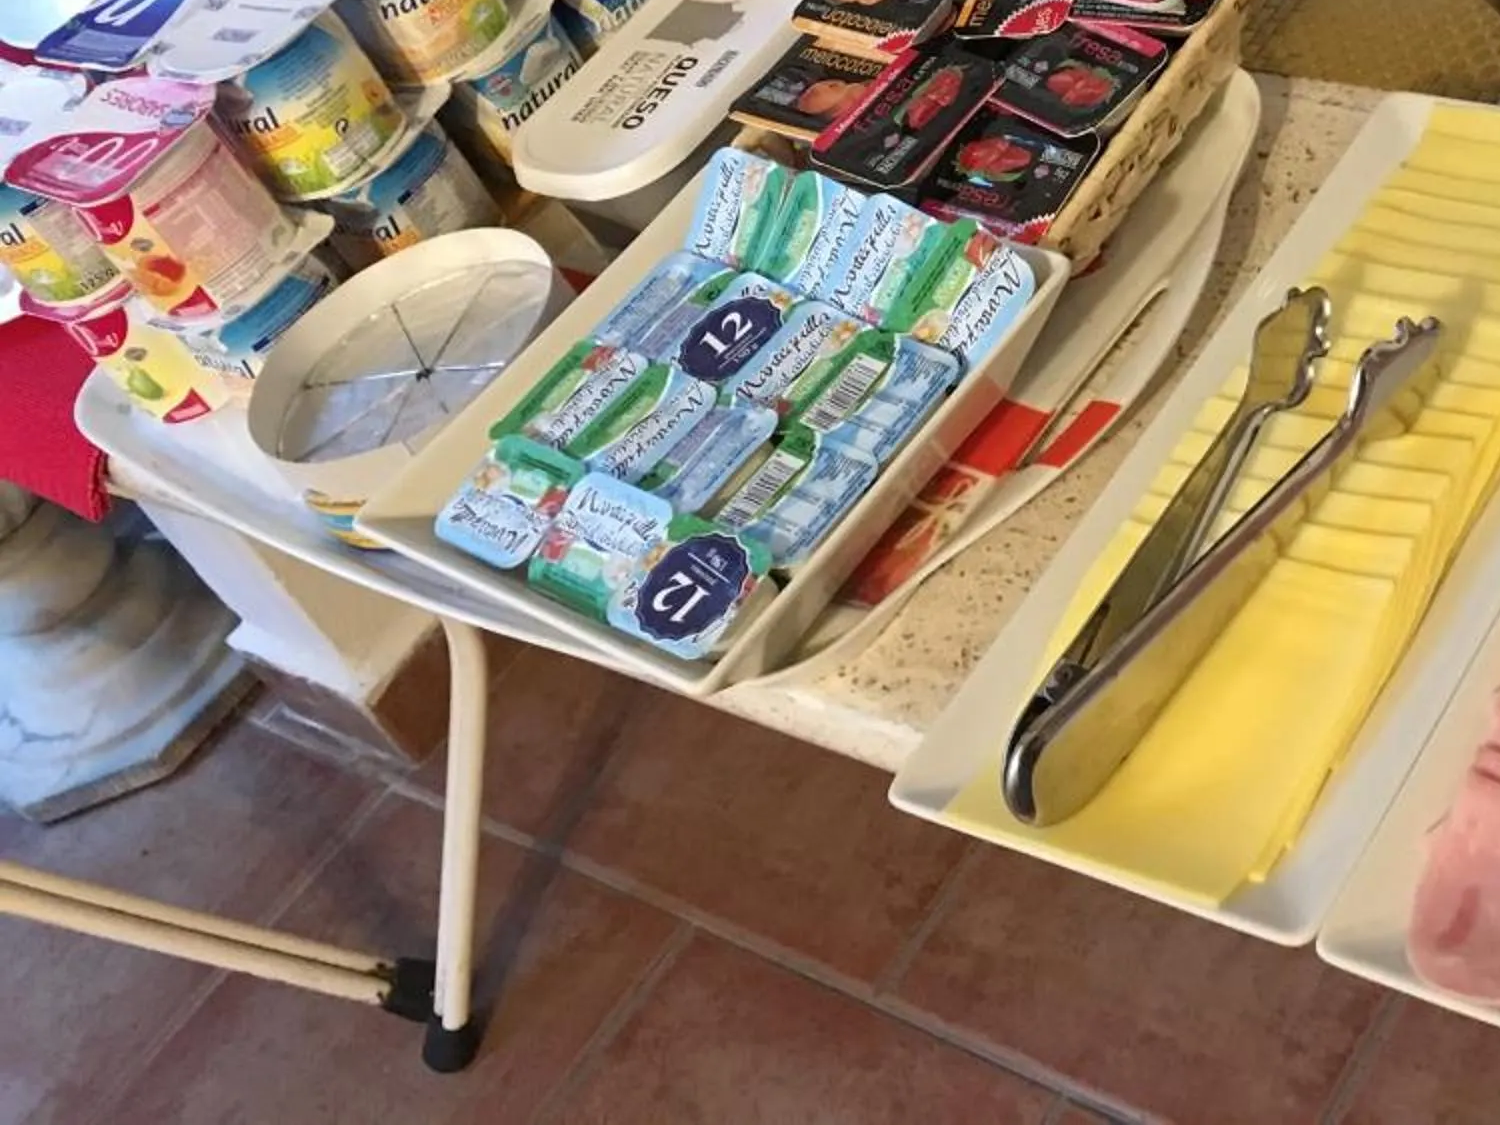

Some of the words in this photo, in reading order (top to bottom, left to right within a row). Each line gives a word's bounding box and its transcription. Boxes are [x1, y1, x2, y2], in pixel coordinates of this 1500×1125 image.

[502, 52, 581, 131] natural
[622, 56, 699, 129] QUESO
[696, 307, 754, 359] 12
[653, 571, 709, 621] 12
